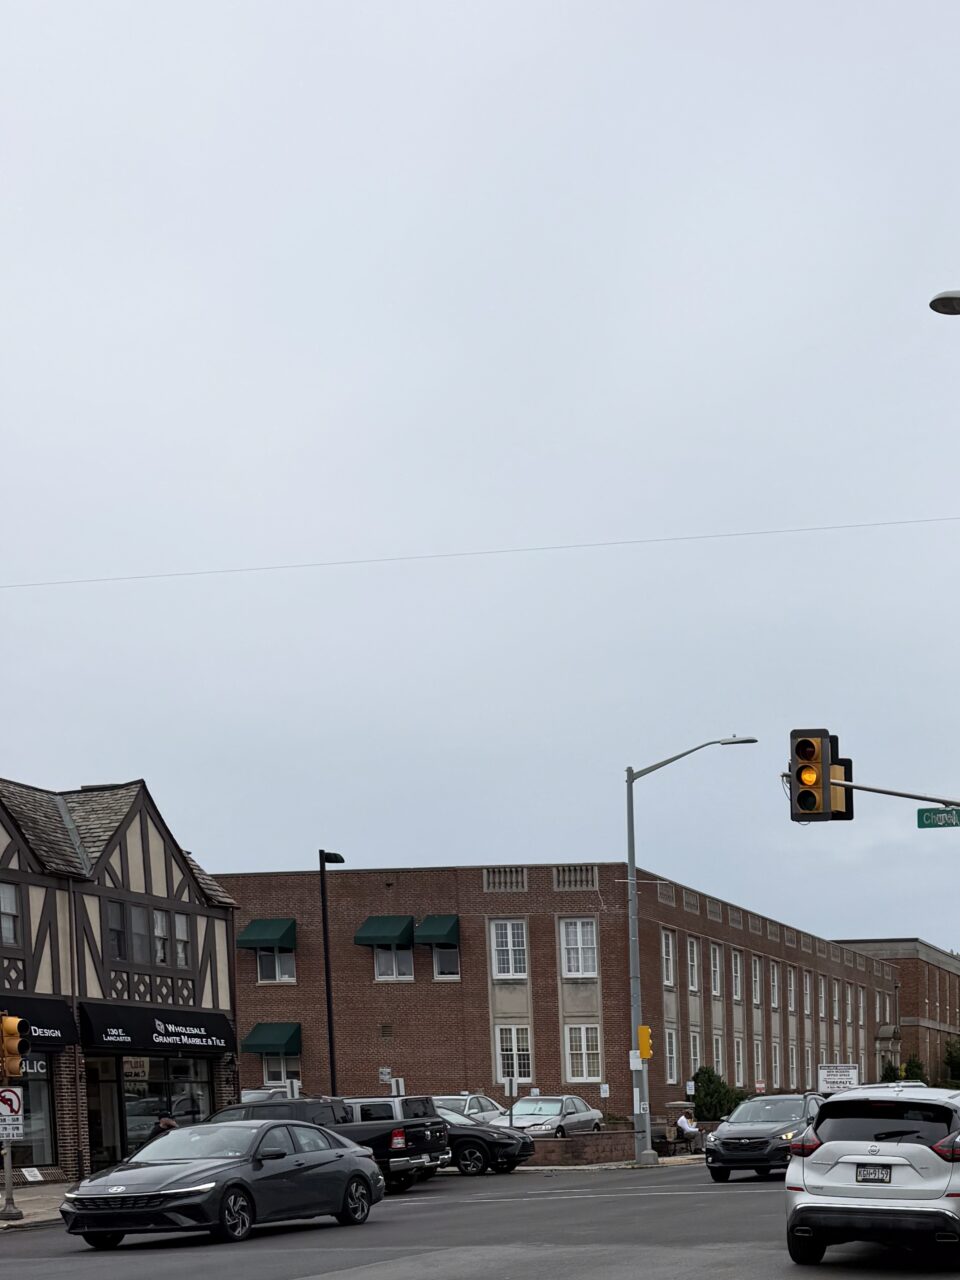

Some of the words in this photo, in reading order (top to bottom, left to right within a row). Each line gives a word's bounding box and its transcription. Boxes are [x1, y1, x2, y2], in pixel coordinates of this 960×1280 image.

[31, 1026, 62, 1037] DESIGN
[165, 1023, 207, 1034] WHOLESALE
[153, 1033, 181, 1043] GRANITE
[181, 1035, 207, 1045] MARBLE
[211, 1037, 226, 1046] TILE
